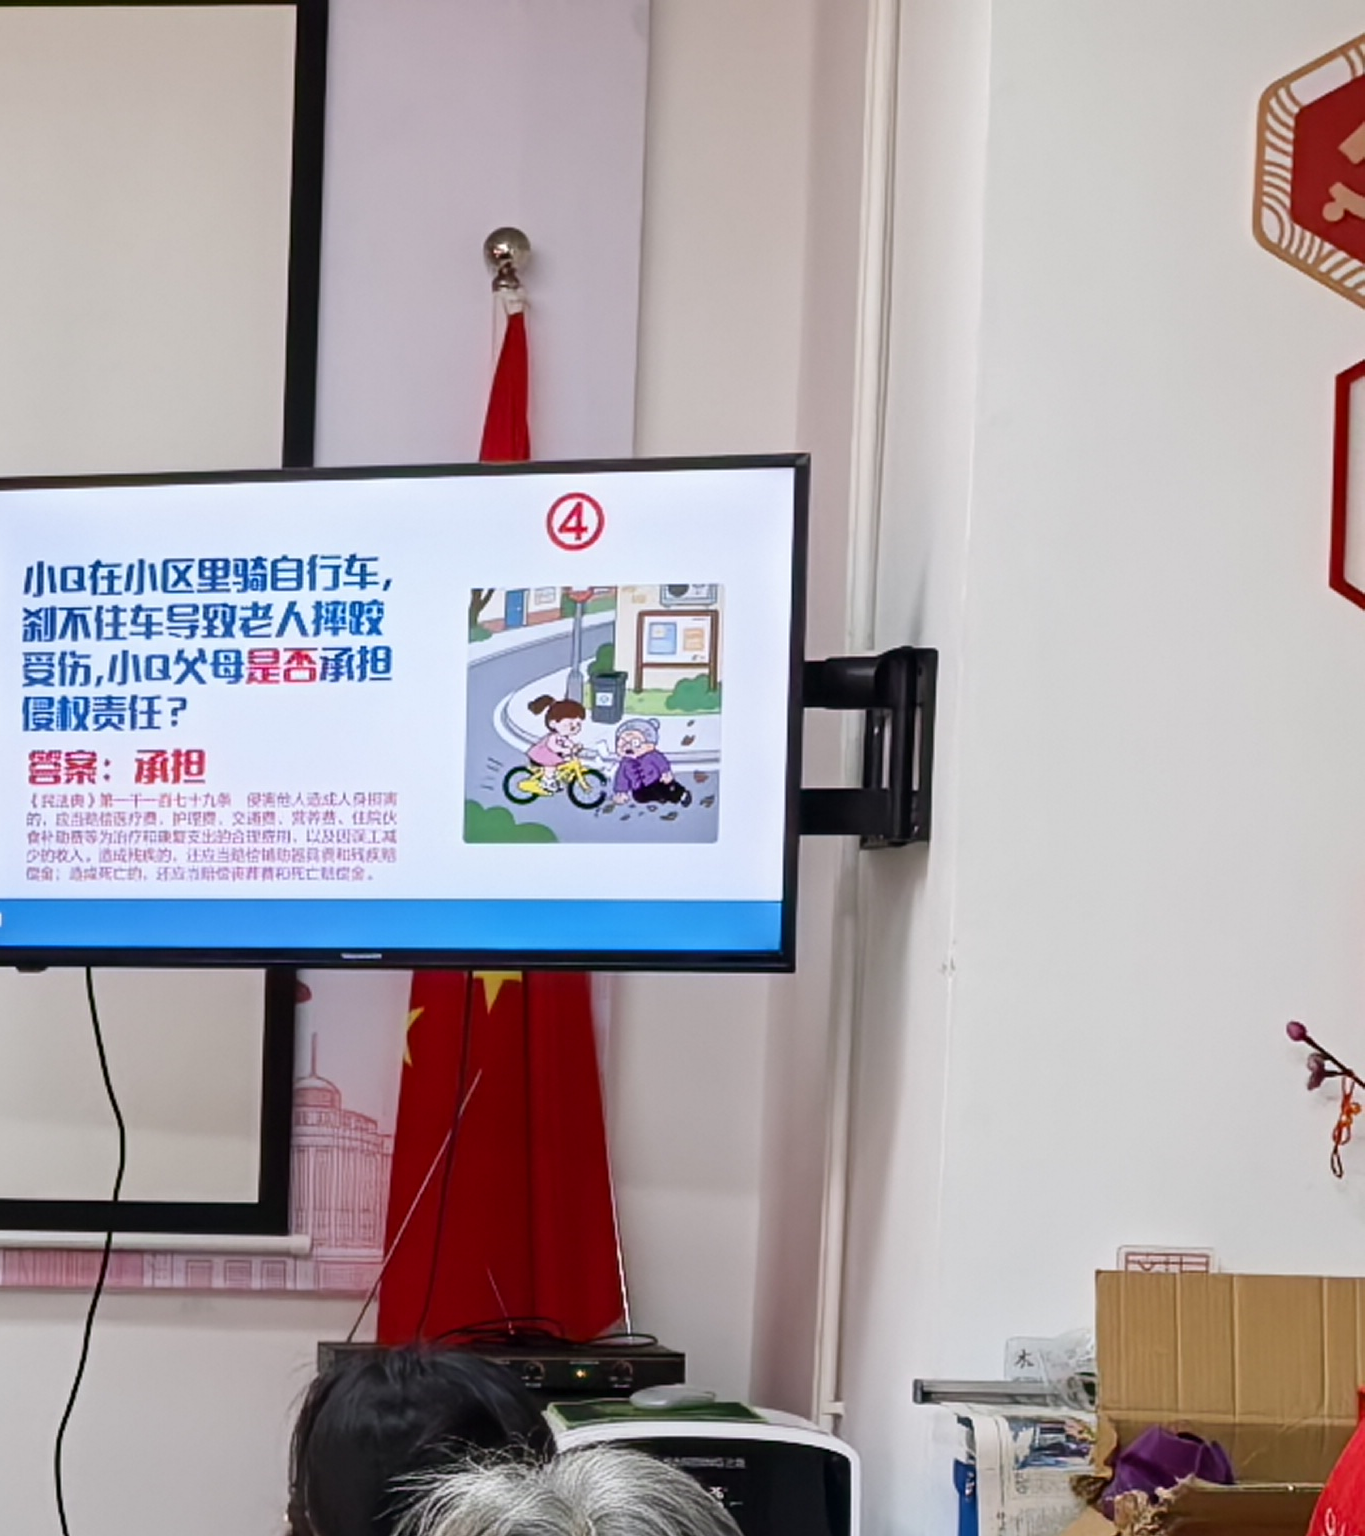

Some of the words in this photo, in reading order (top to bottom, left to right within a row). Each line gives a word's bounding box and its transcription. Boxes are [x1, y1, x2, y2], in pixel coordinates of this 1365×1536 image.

[21, 599, 385, 643] 刹不住车导致老人摔跤
